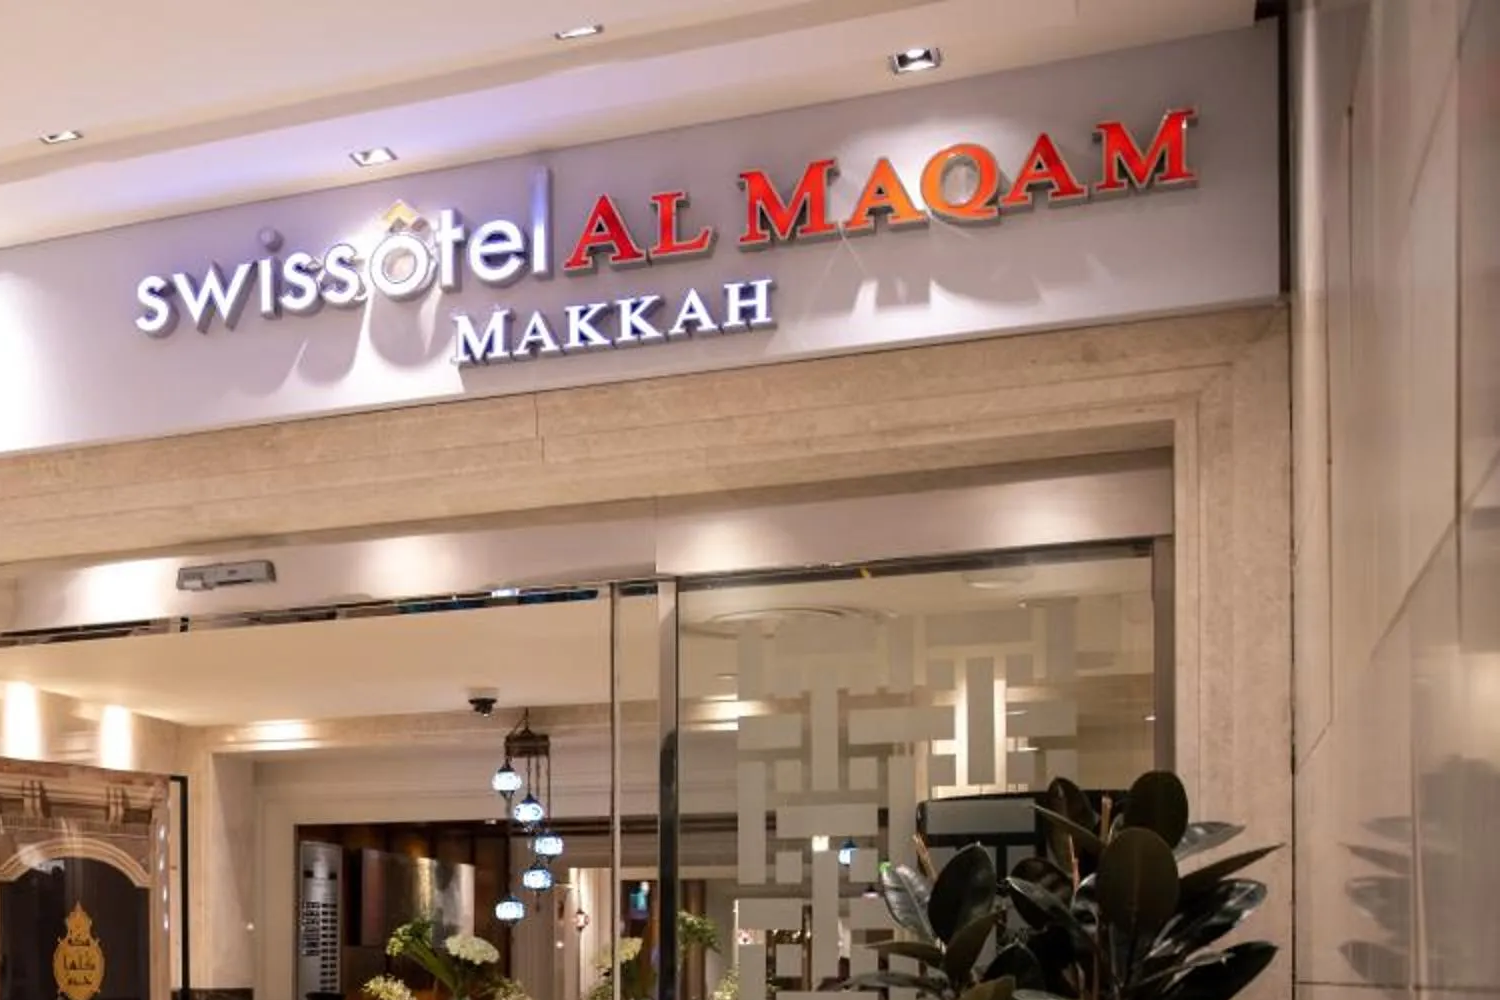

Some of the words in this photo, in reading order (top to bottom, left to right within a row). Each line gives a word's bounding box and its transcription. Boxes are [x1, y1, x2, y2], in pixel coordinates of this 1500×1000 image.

[563, 192, 711, 271] AL
[738, 109, 1198, 243] MAQAM
[452, 278, 773, 363] MAKKAH
